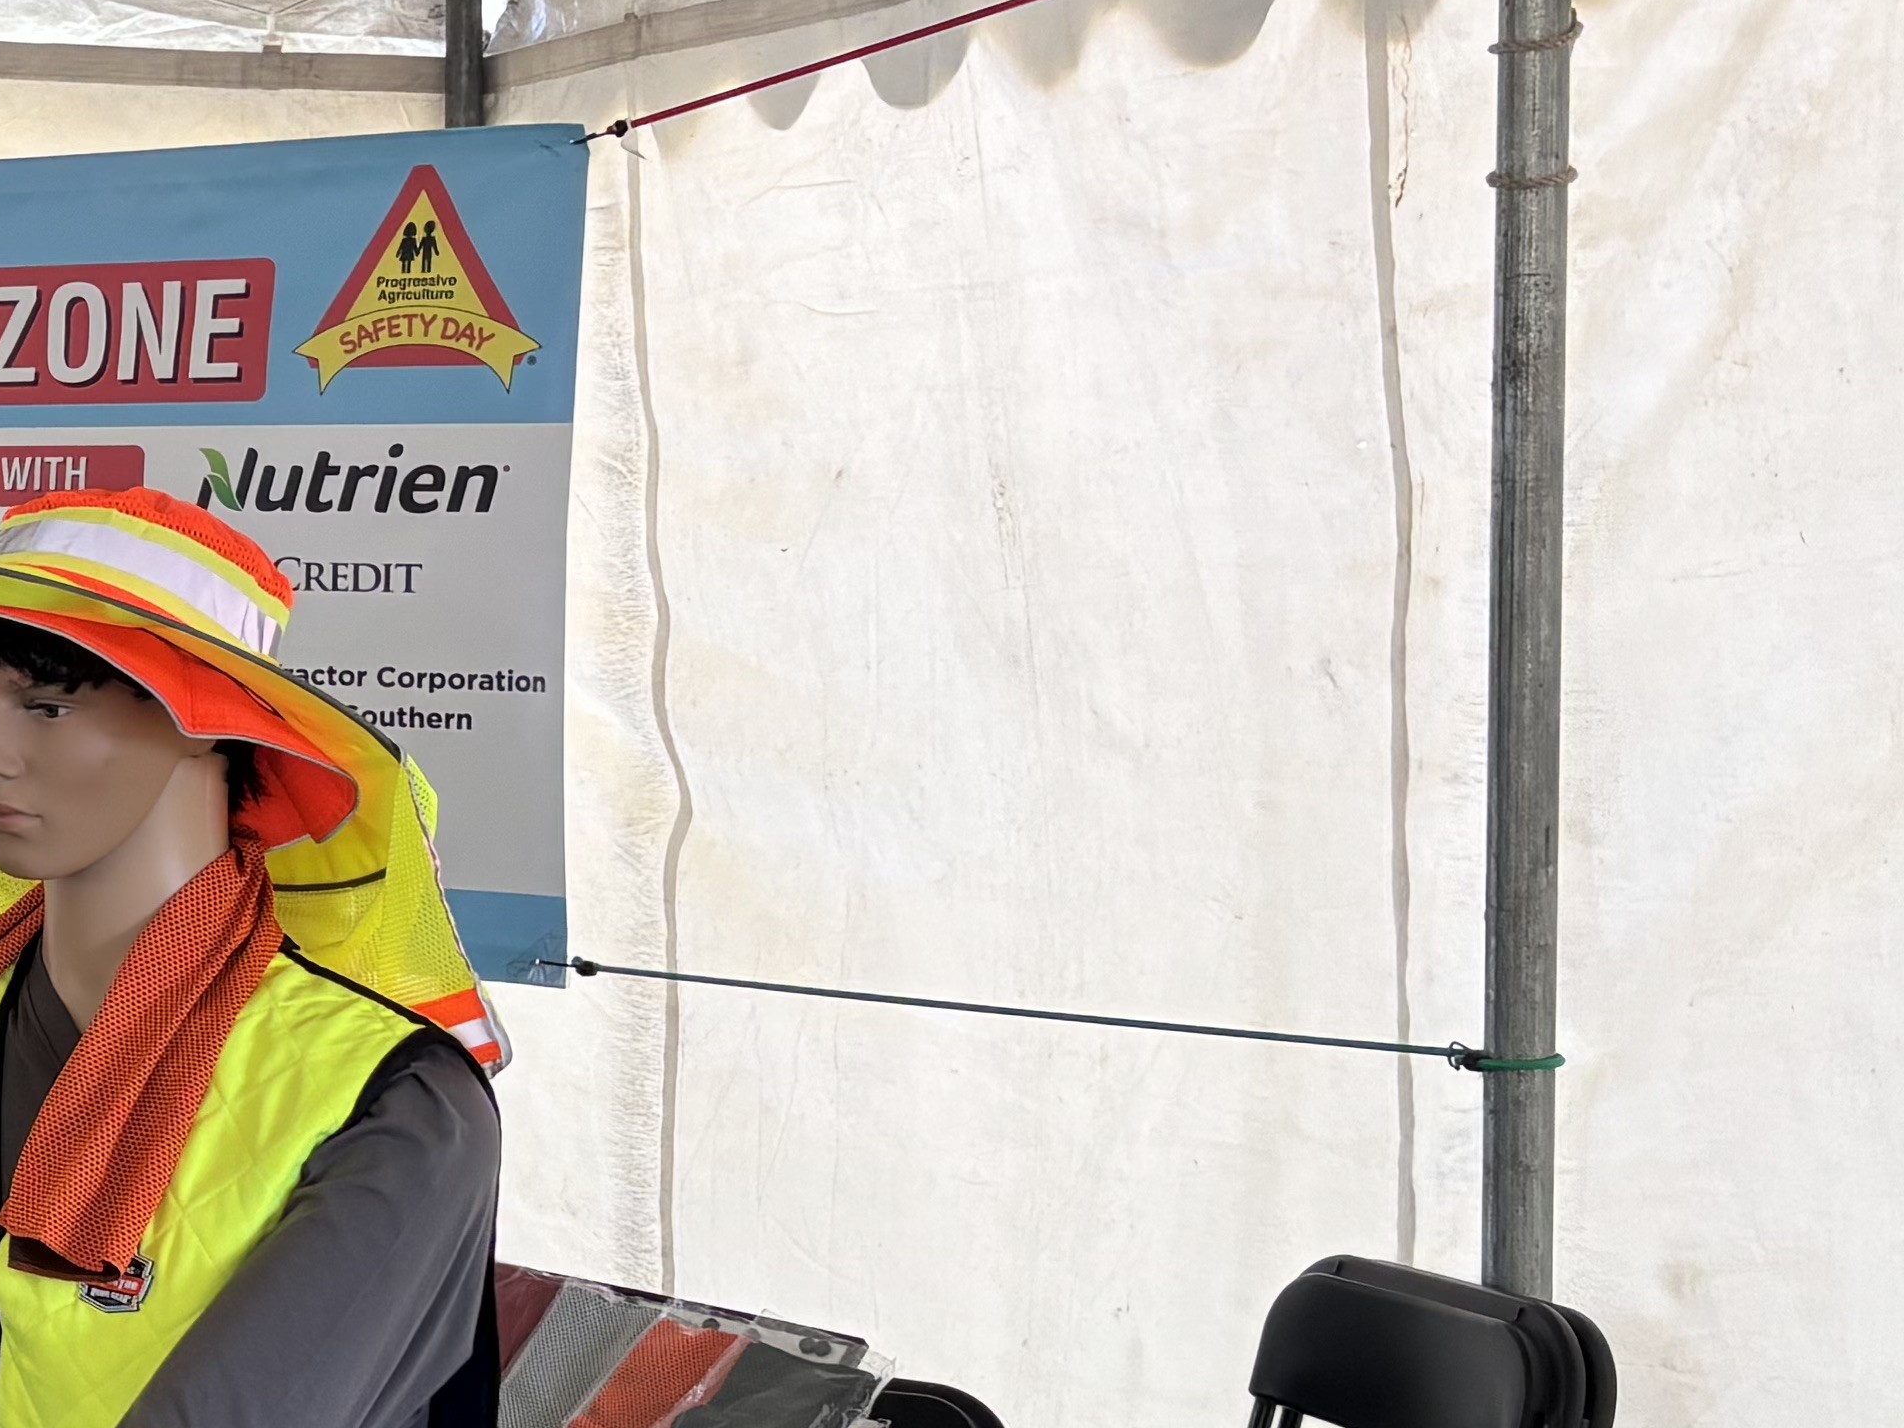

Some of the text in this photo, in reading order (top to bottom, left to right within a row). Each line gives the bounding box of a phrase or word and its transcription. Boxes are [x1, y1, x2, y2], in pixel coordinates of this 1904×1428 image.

[376, 274, 457, 290] Progressive
[378, 288, 454, 304] Agriculture
[339, 313, 495, 354] SAFETY DAY
[1, 456, 88, 490] WITH
[196, 443, 499, 513] Nutrien
[275, 557, 422, 594] CREDIT
[377, 667, 546, 693] Corporation
